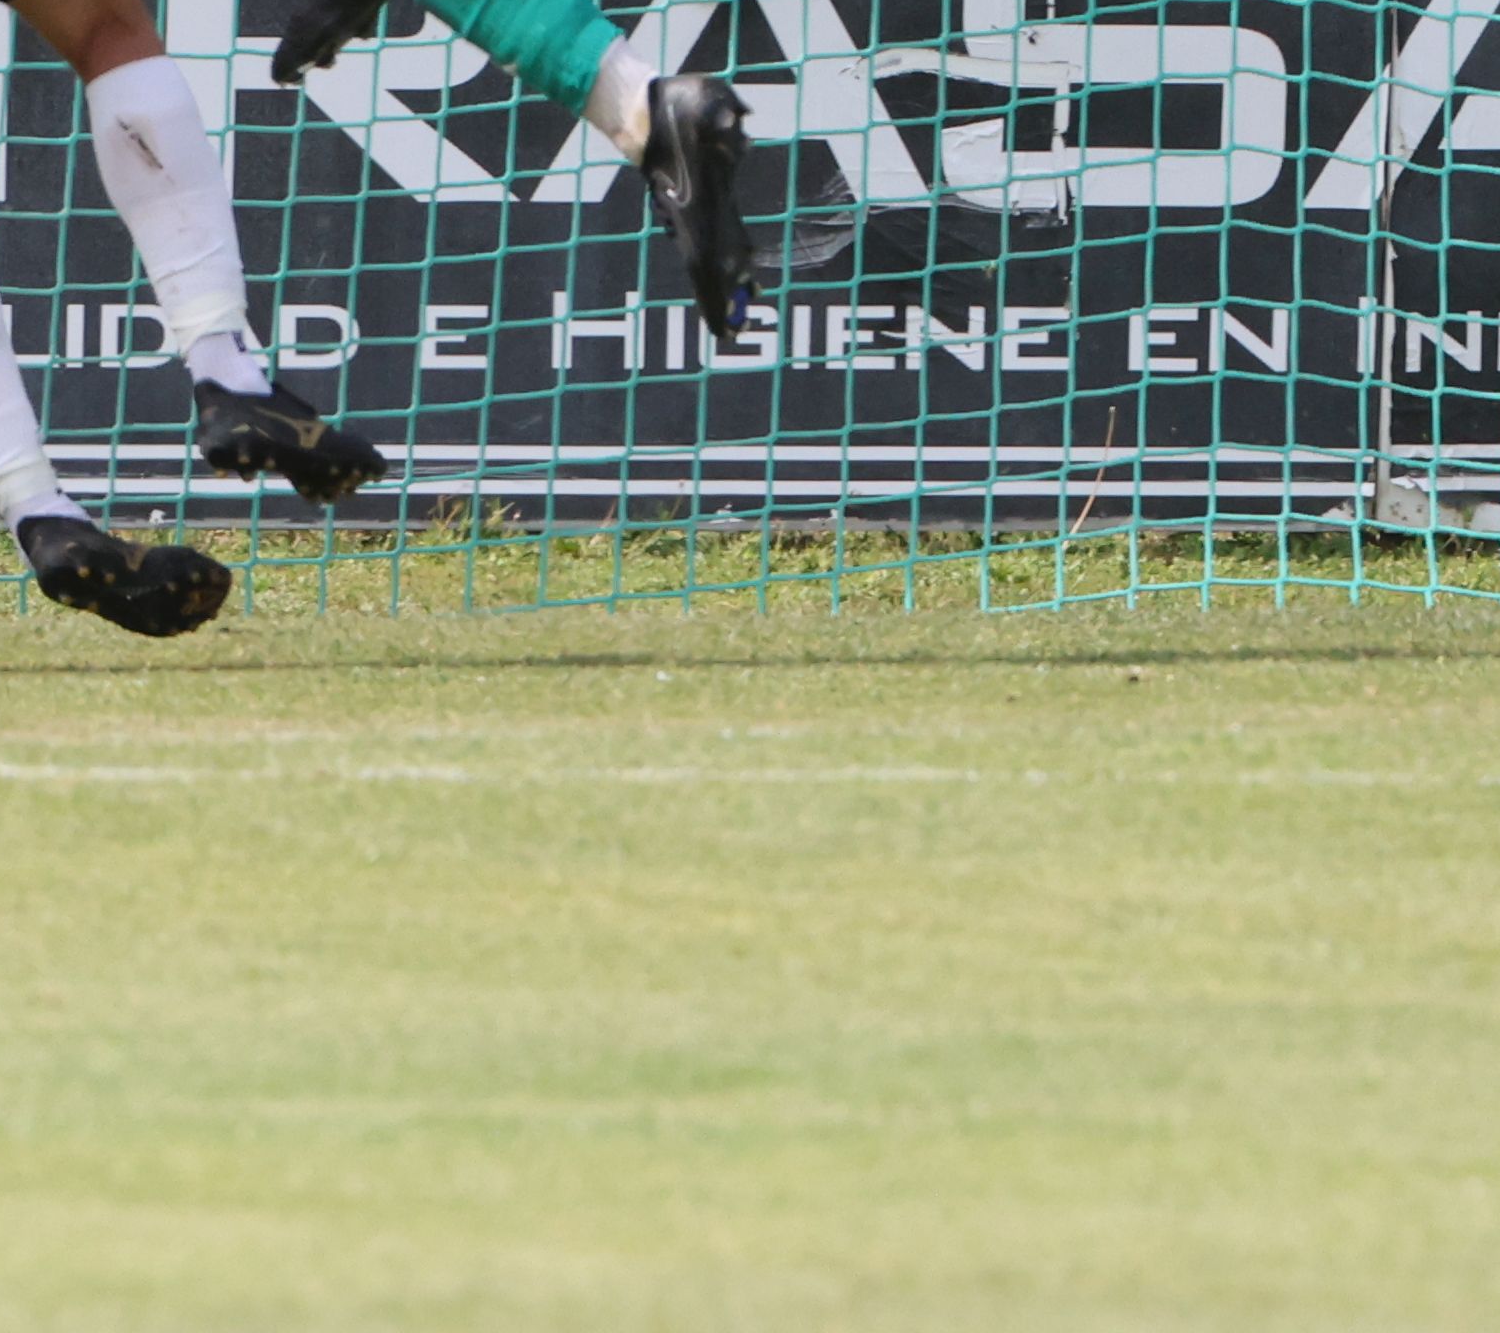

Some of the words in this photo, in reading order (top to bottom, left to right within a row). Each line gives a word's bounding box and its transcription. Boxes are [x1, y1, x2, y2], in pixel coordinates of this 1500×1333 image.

[422, 304, 489, 370] E
[551, 290, 1072, 372] HIGIENE
[1128, 305, 1289, 375] EN
